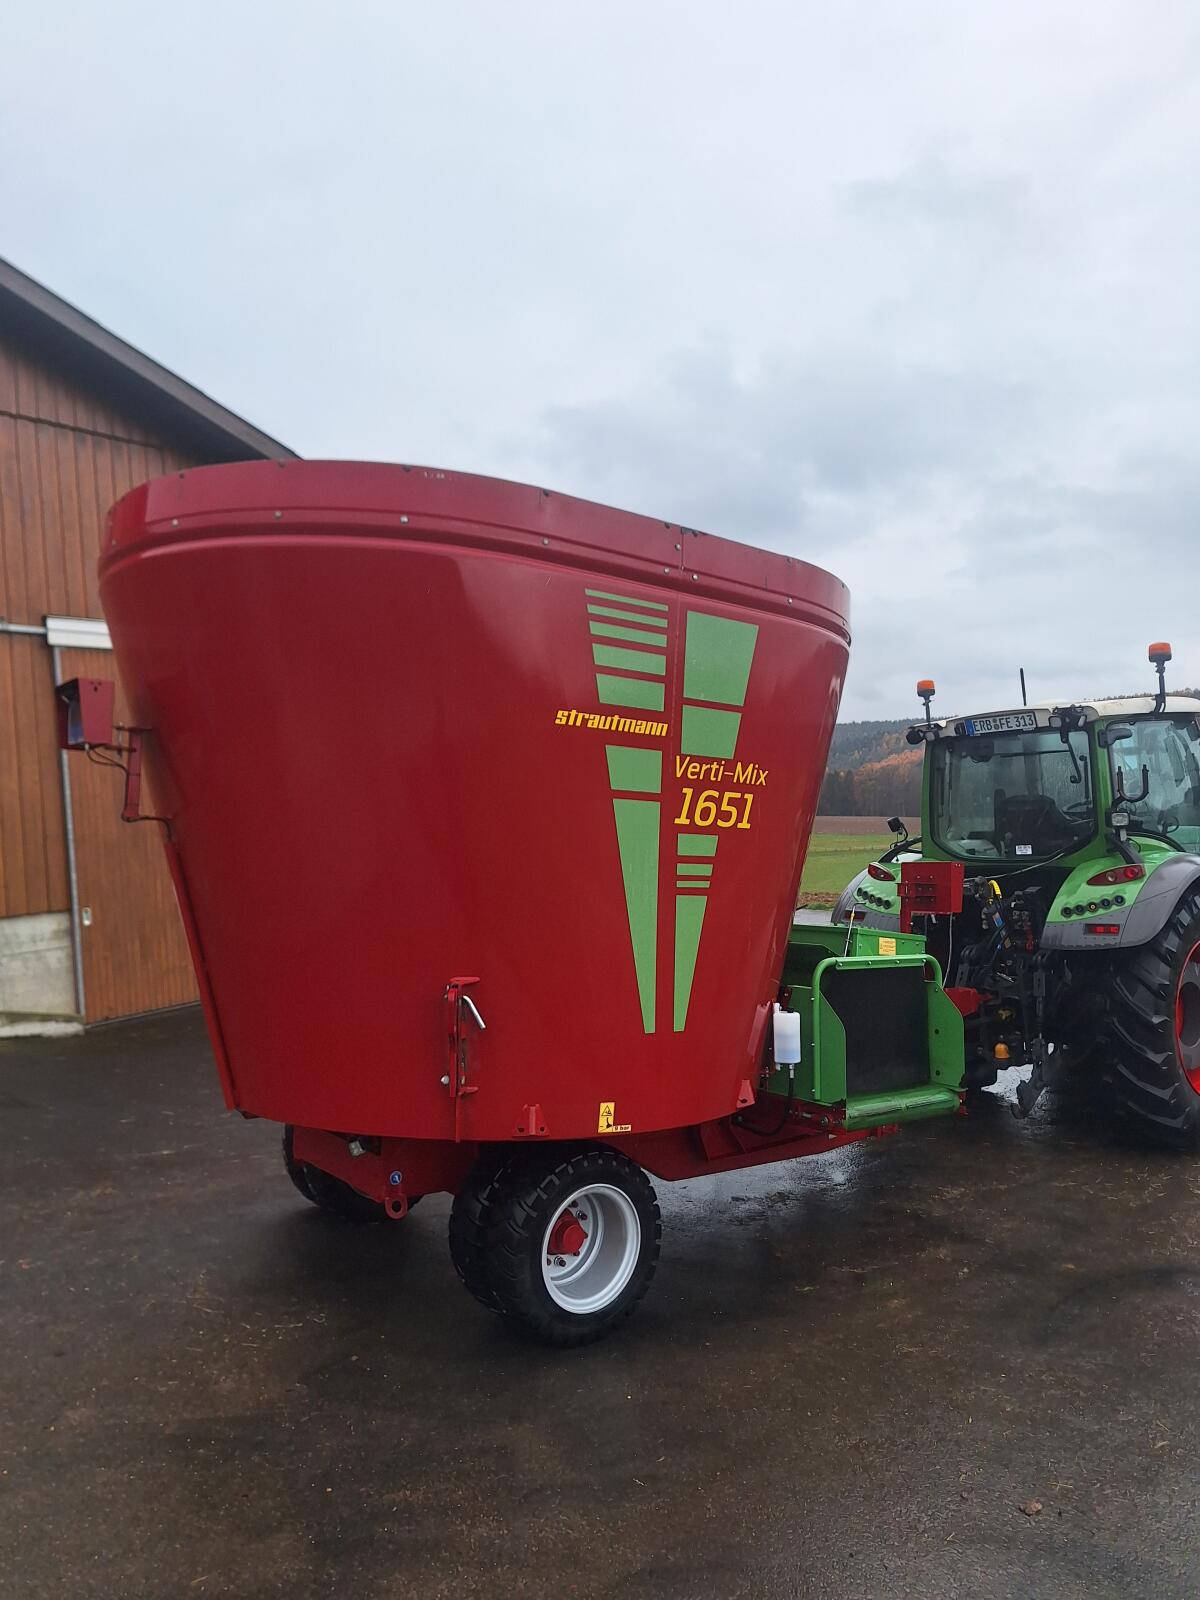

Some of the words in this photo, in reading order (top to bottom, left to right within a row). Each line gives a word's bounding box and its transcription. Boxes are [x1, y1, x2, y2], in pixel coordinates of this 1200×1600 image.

[555, 708, 669, 737] strautmann
[973, 719, 993, 732] ERB
[999, 717, 1013, 730] FE
[1014, 714, 1034, 727] 313
[674, 755, 769, 786] Verti-Mix
[673, 787, 754, 829] 1651
